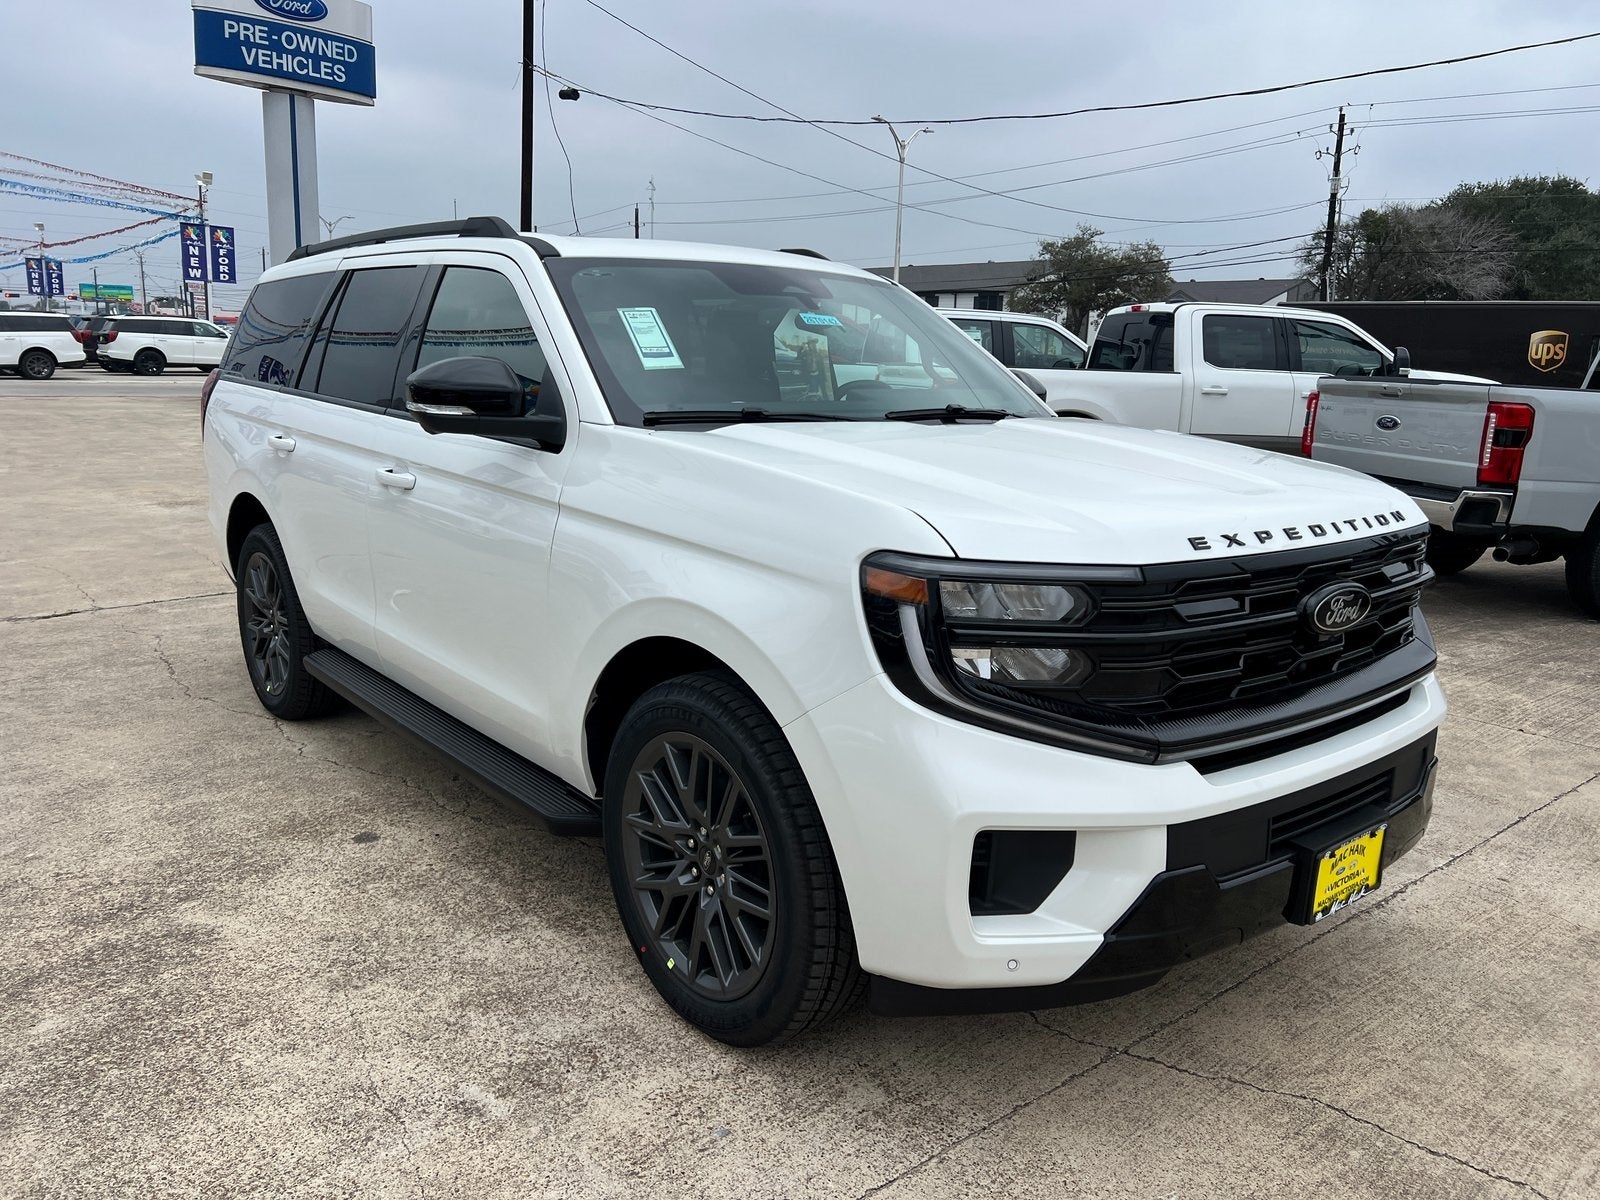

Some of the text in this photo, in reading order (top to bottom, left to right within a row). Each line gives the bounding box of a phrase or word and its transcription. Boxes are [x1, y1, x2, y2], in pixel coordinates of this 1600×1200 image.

[223, 20, 358, 63] PRE-OWNED
[240, 46, 347, 82] VEHICLES
[188, 245, 201, 278] NEW
[218, 248, 229, 281] FORD
[31, 272, 41, 293] NEW
[51, 273, 60, 294] FORD
[1531, 343, 1565, 366] ups
[1320, 429, 1468, 455] SUPER DUTY
[1187, 510, 1407, 551] EXPEDITION
[1325, 594, 1363, 626] Ford
